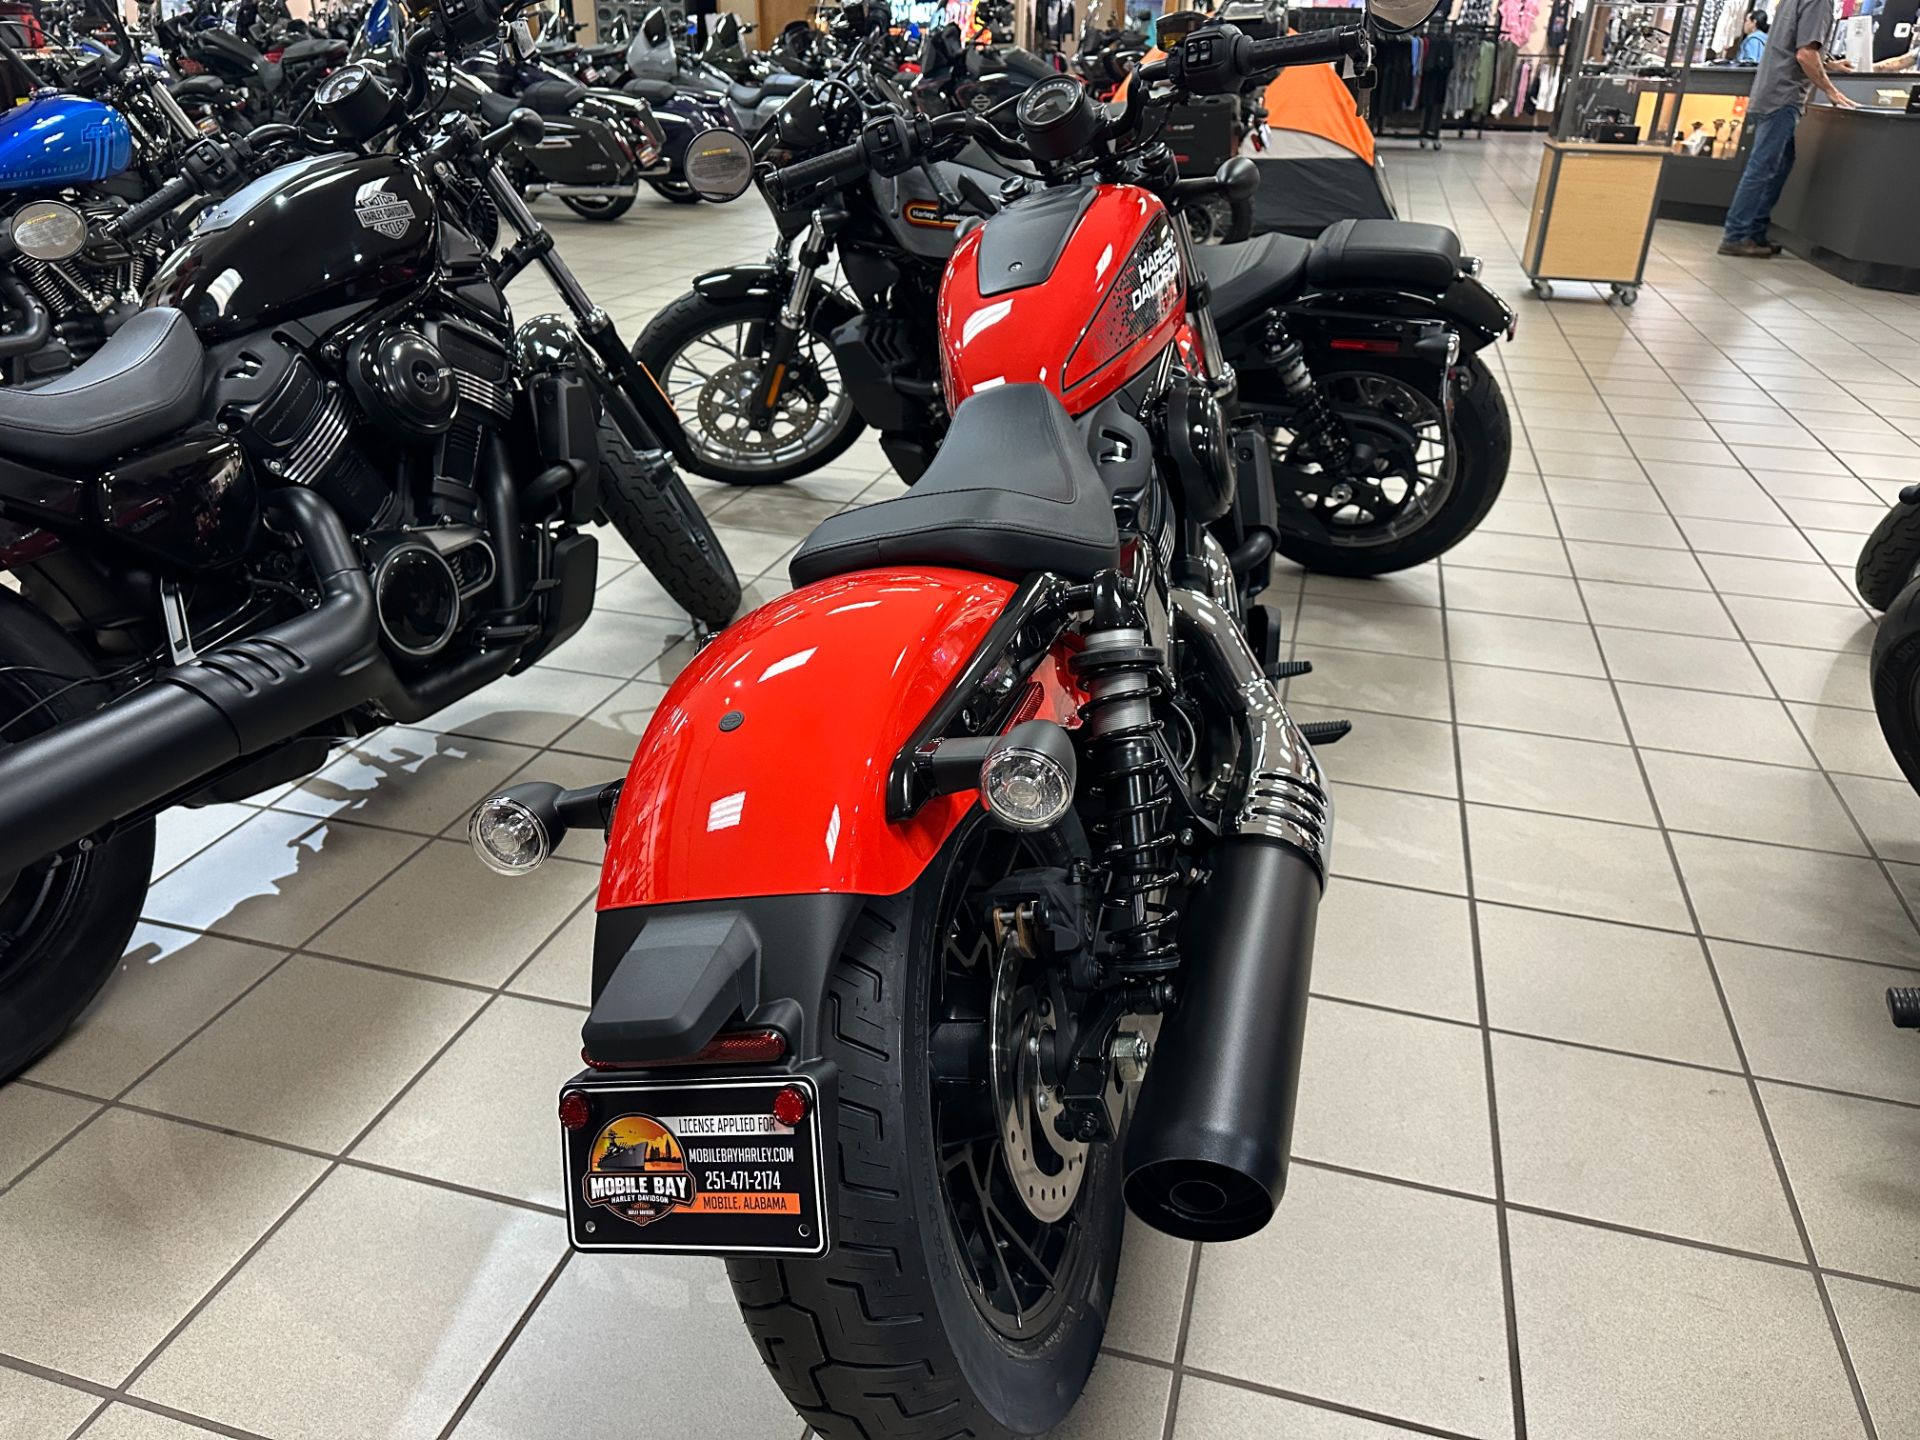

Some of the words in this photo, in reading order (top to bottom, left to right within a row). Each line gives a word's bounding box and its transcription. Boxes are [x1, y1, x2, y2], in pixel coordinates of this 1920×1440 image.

[368, 195, 393, 206] MOTOR
[380, 220, 405, 234] CYCLES
[1131, 251, 1180, 311] DAVIDSON
[679, 1118, 715, 1134] LICENSE
[717, 1117, 755, 1133] APPLIED
[759, 1116, 776, 1132] FOR
[688, 1147, 794, 1163] MOBILEBAYHARLEY.COM
[590, 1177, 648, 1200] MOBILE
[653, 1176, 687, 1199] BAY
[705, 1170, 781, 1190] 251-471-2174
[611, 1195, 635, 1204] HARLEY
[638, 1194, 669, 1204] DAVIDSON
[703, 1196, 741, 1210] MOBILE,
[744, 1196, 787, 1210] ALABAMA
